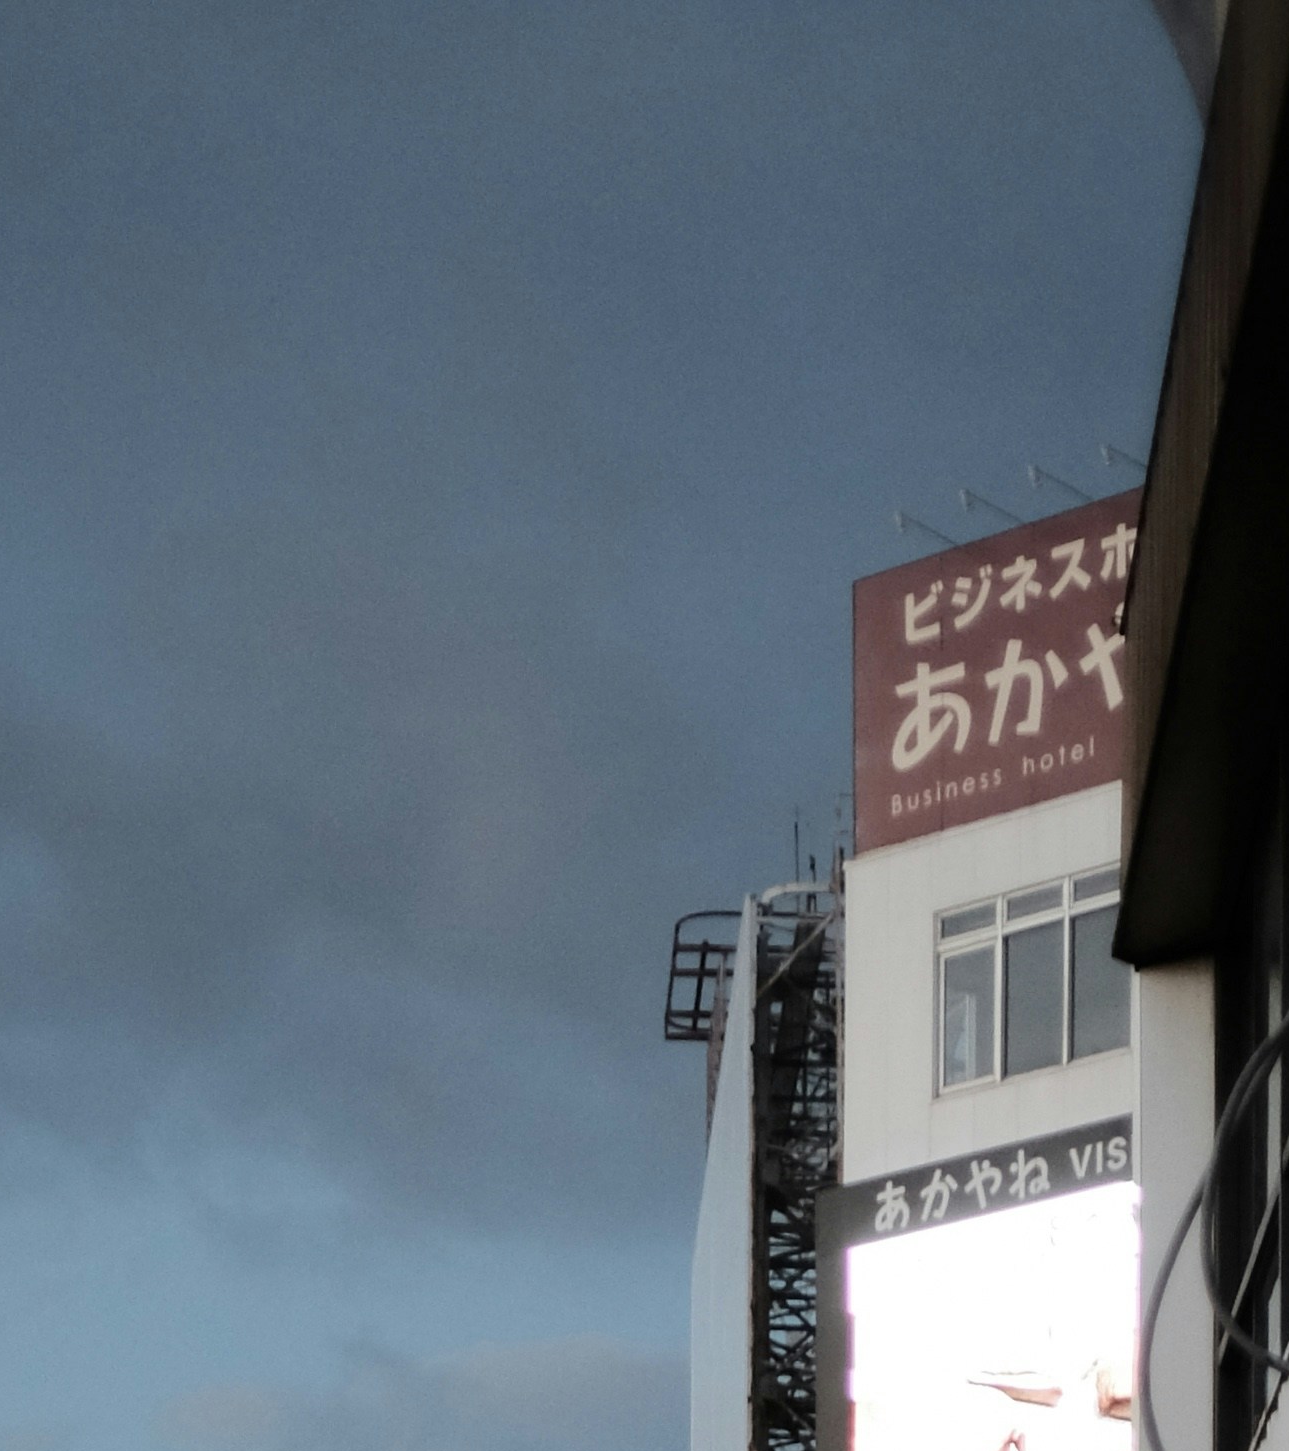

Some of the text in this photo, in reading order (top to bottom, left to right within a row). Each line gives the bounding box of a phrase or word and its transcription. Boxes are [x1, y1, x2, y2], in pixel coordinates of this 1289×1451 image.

[890, 736, 1095, 816] Business hotel
[874, 1149, 1050, 1233] あかやね
